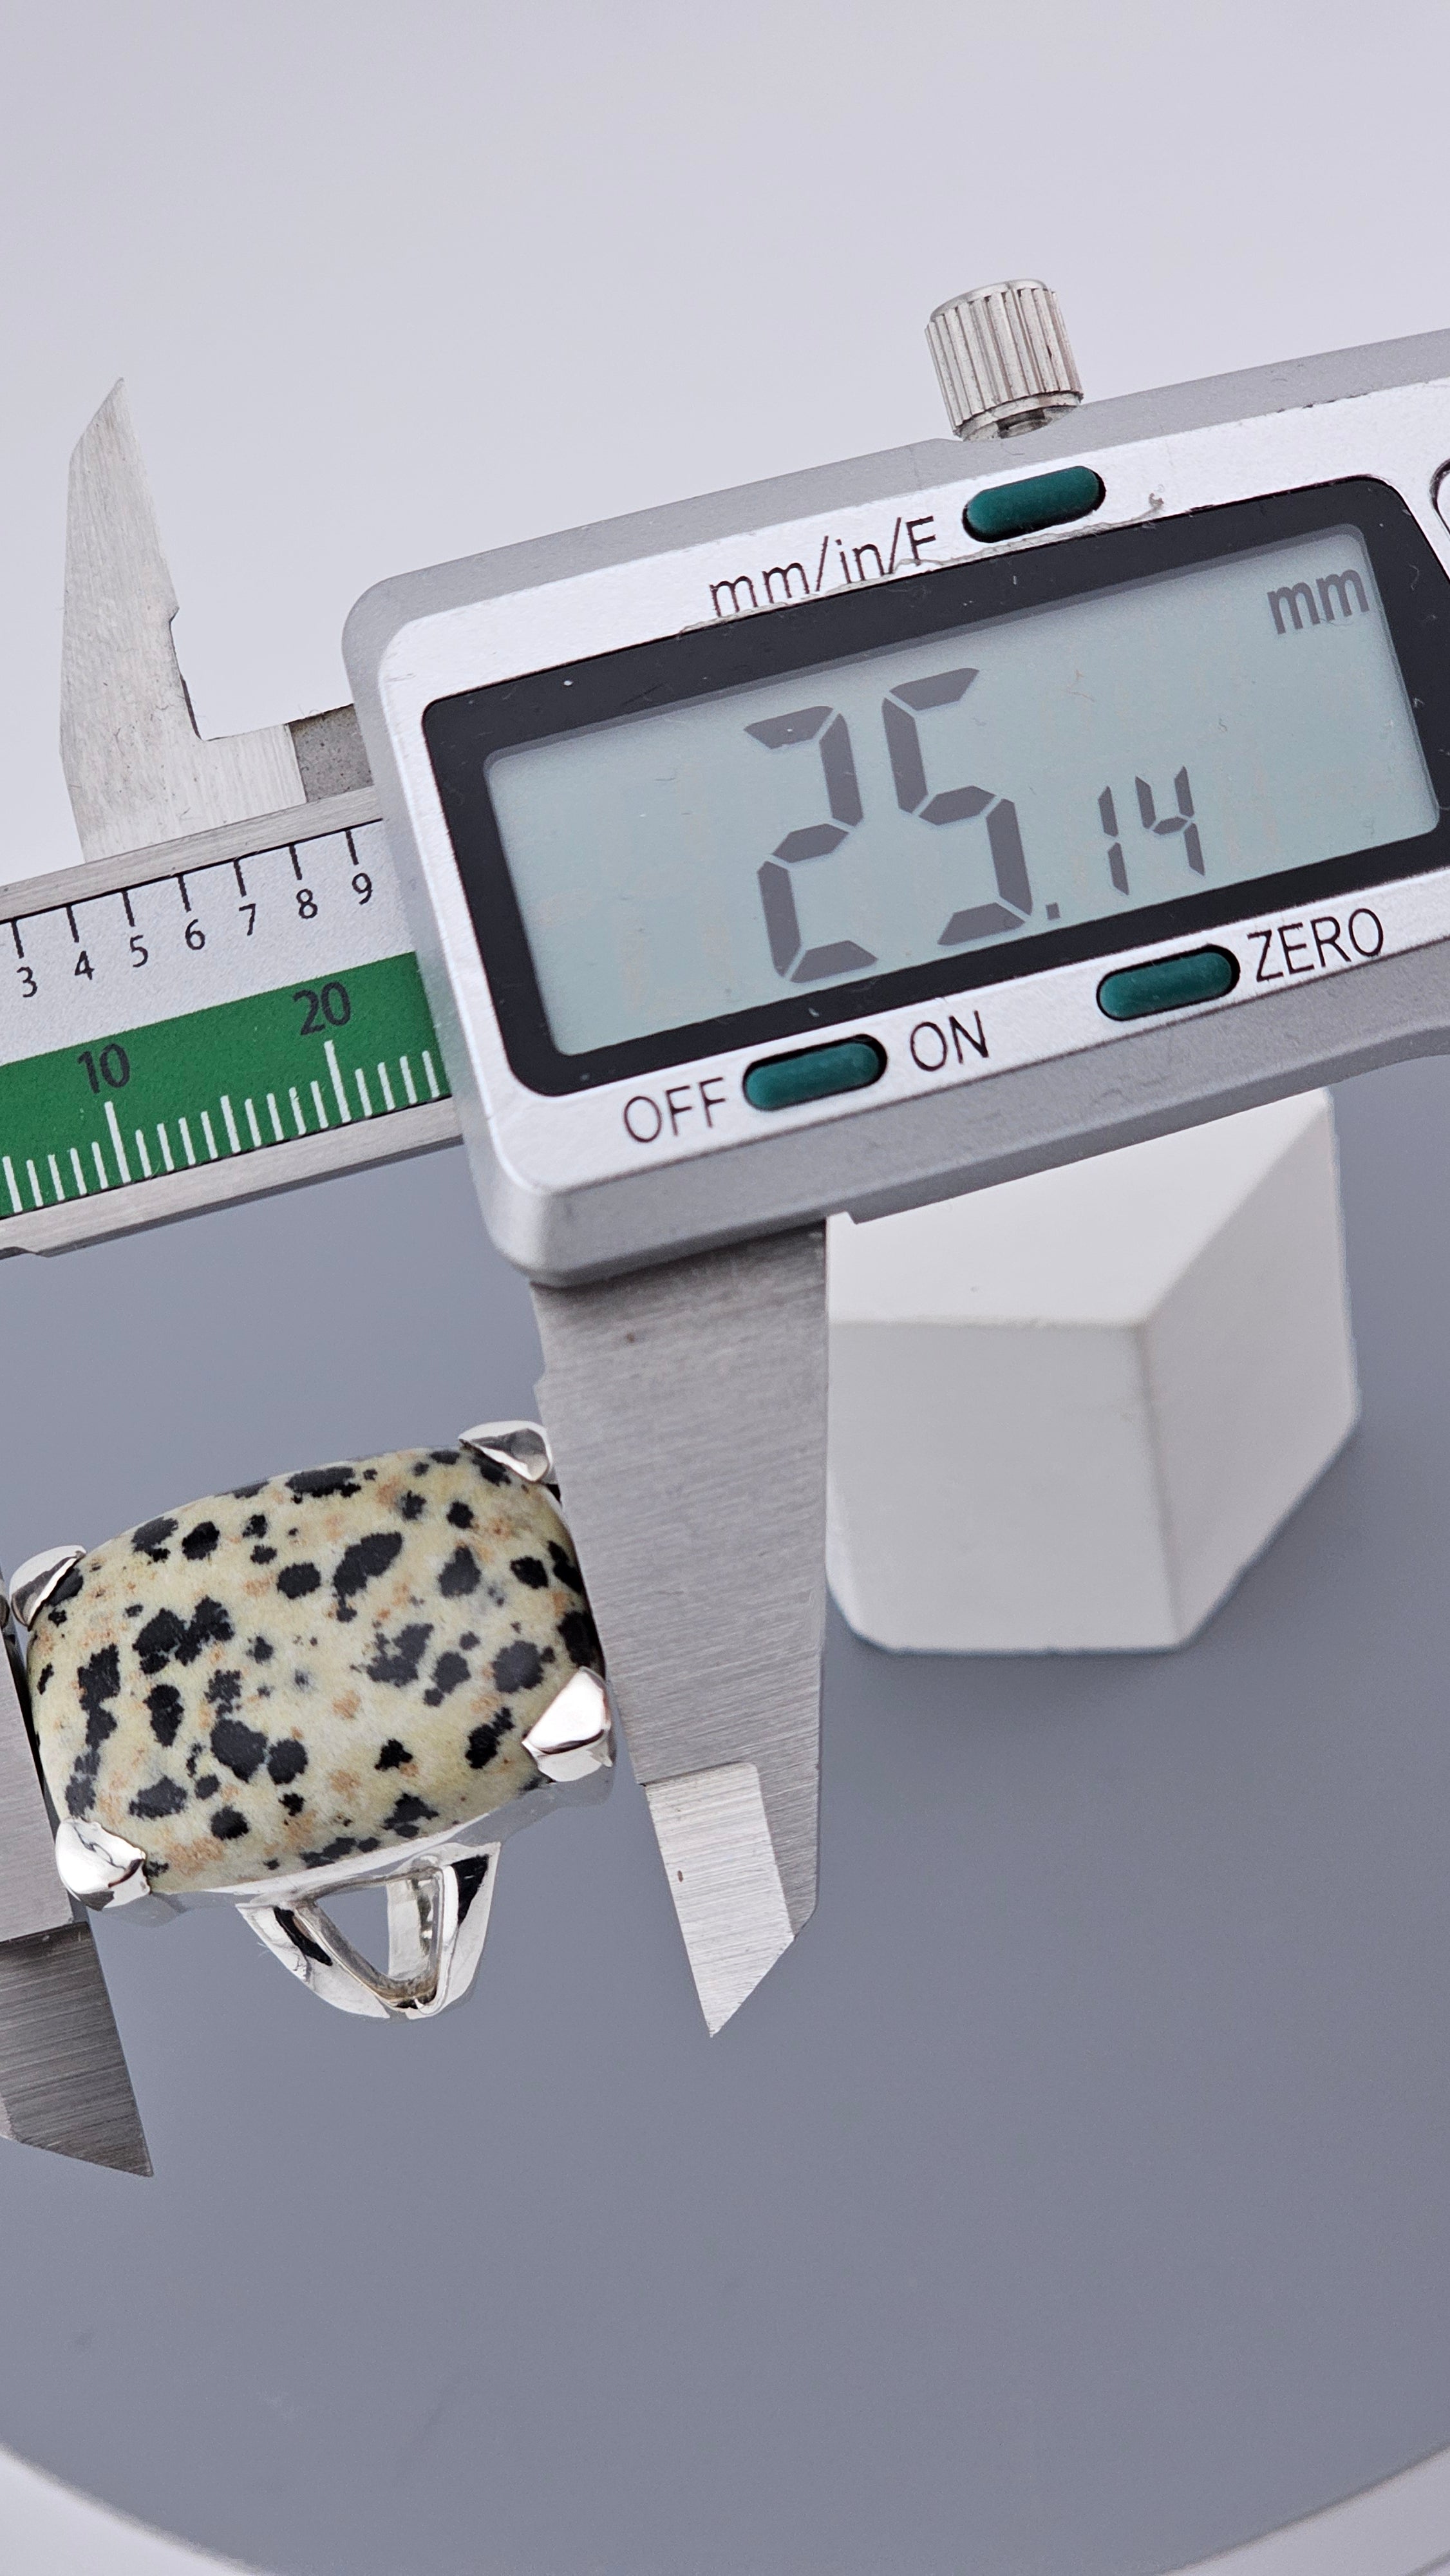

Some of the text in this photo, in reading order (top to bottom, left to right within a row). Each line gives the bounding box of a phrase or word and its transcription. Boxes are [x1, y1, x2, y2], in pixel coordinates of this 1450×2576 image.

[710, 515, 937, 617] mm/in/F
[1266, 569, 1370, 635] mm
[744, 667, 1205, 983] 25.14
[17, 872, 373, 998] 3 4 5 6 7 8 9
[1246, 907, 1385, 984] ZERO
[77, 981, 352, 1094] 10 20
[909, 1010, 990, 1073] ON
[622, 1076, 728, 1144] OFF
